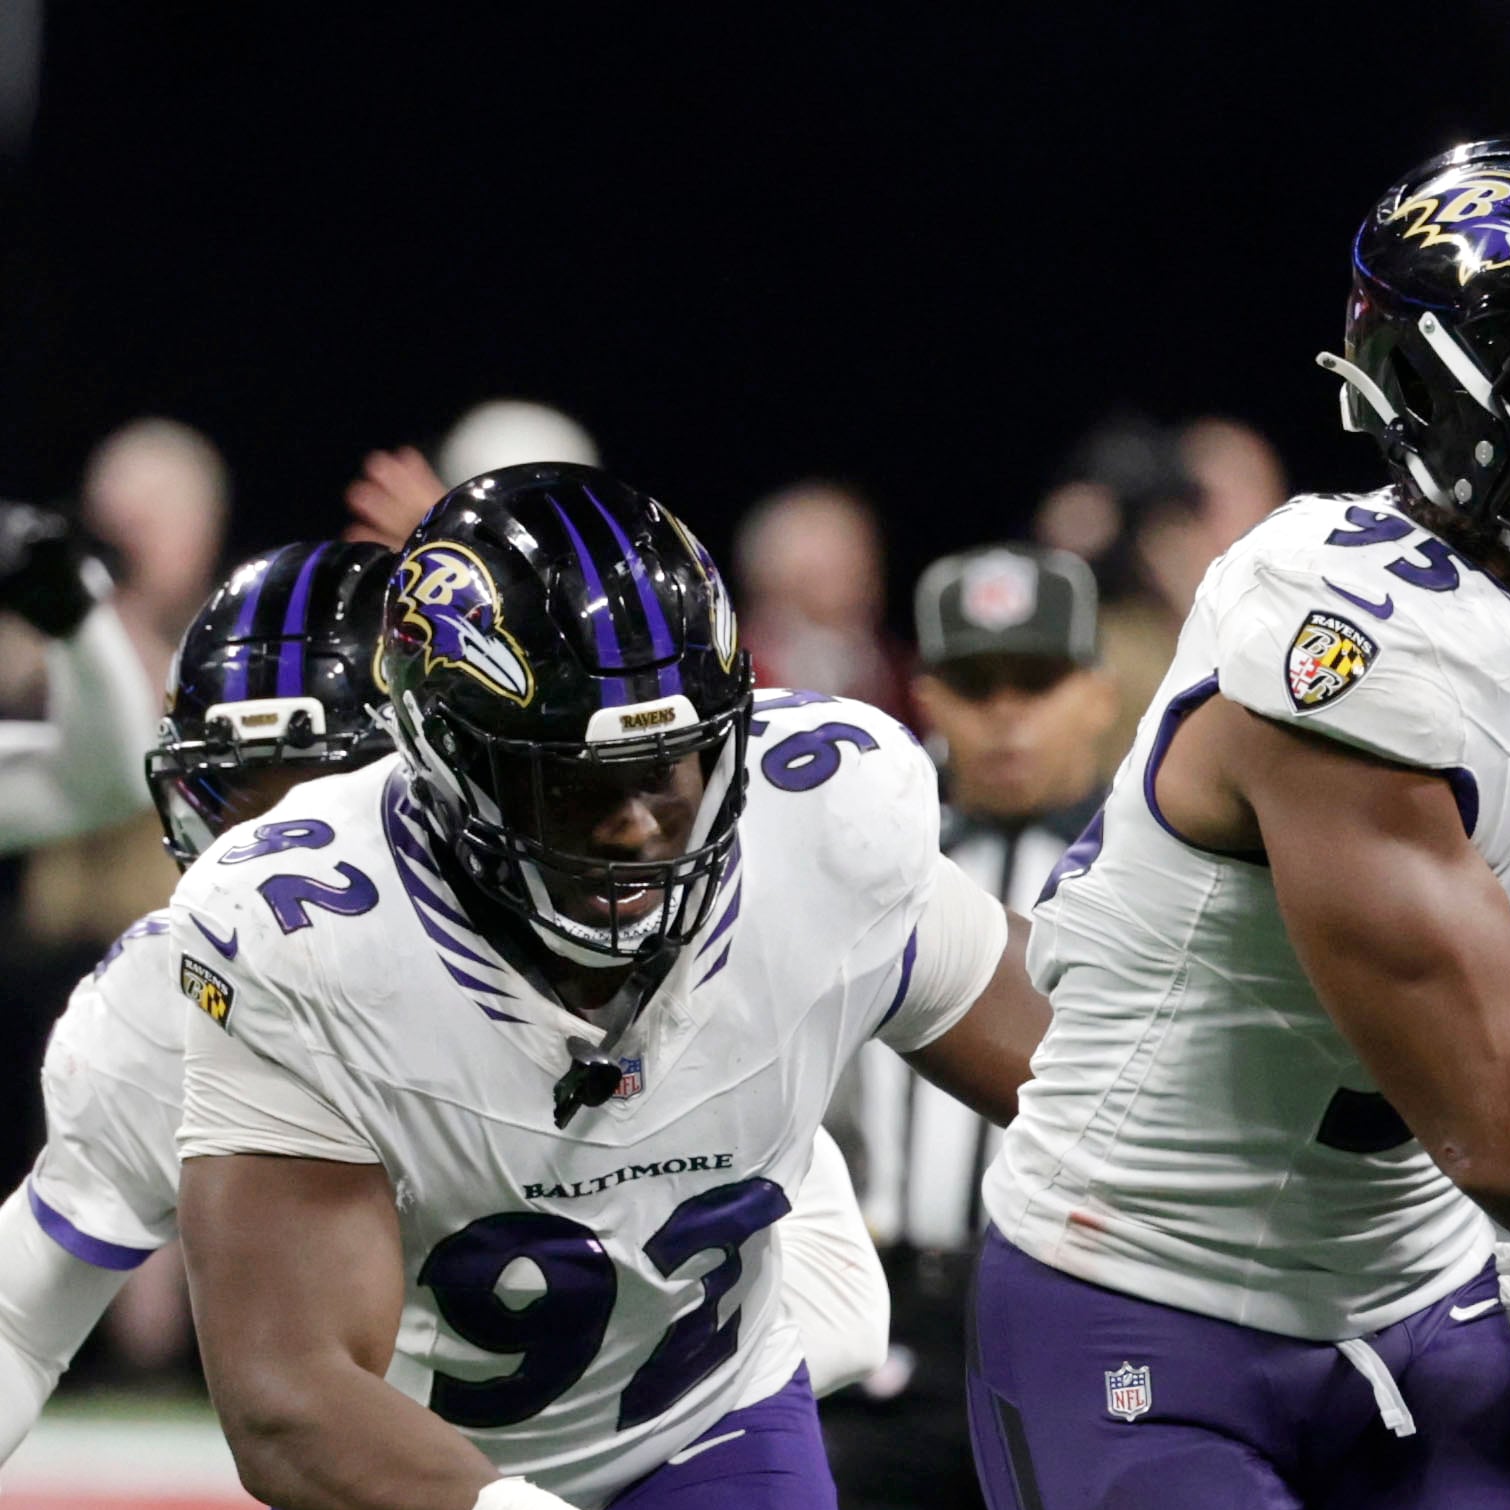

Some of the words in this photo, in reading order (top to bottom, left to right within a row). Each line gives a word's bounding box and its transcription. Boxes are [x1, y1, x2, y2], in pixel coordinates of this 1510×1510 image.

[1323, 505, 1460, 592] 95
[1311, 614, 1373, 657] RAVENS
[620, 706, 676, 732] RAVENS
[217, 818, 380, 936] 92
[184, 959, 229, 996] RAVENS
[523, 1153, 734, 1200] BALTIMORE
[418, 1177, 793, 1432] 92
[1115, 1389, 1145, 1410] NFL
